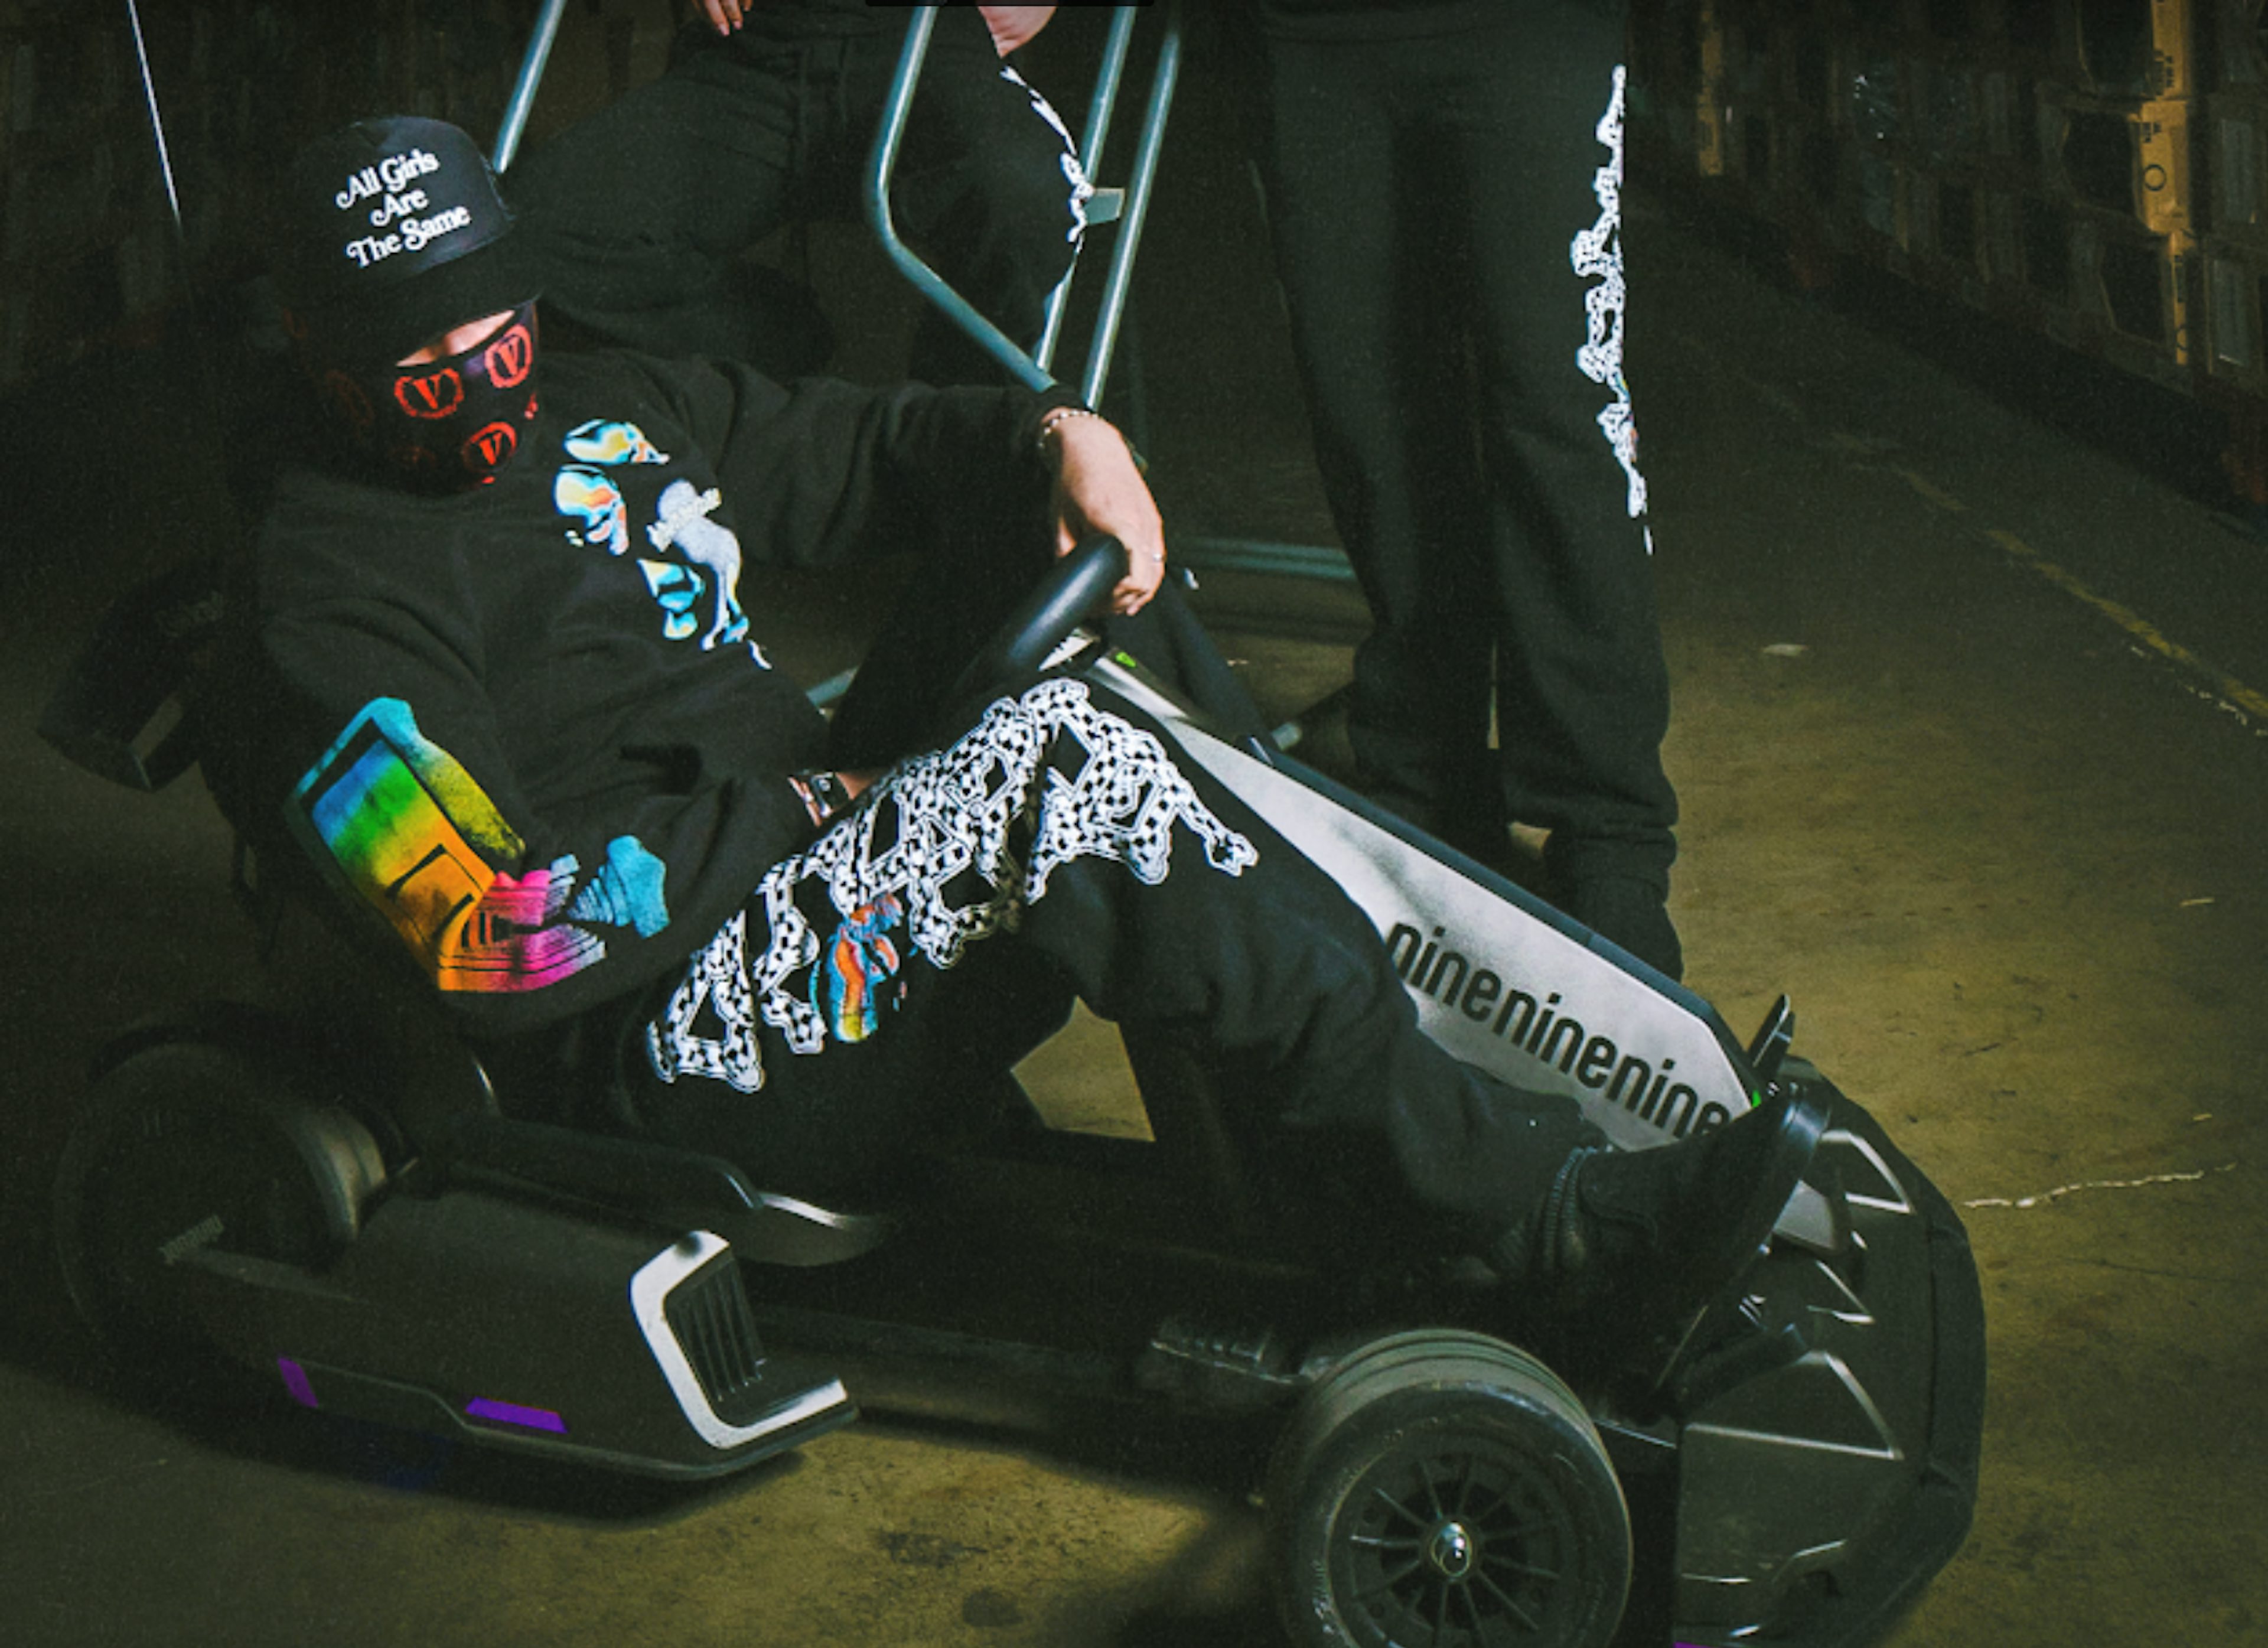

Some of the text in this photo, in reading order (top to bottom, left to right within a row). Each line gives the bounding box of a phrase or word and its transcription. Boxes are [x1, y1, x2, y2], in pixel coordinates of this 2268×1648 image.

[335, 148, 439, 209] All Girls
[370, 189, 429, 226] Are
[345, 206, 471, 268] The Same
